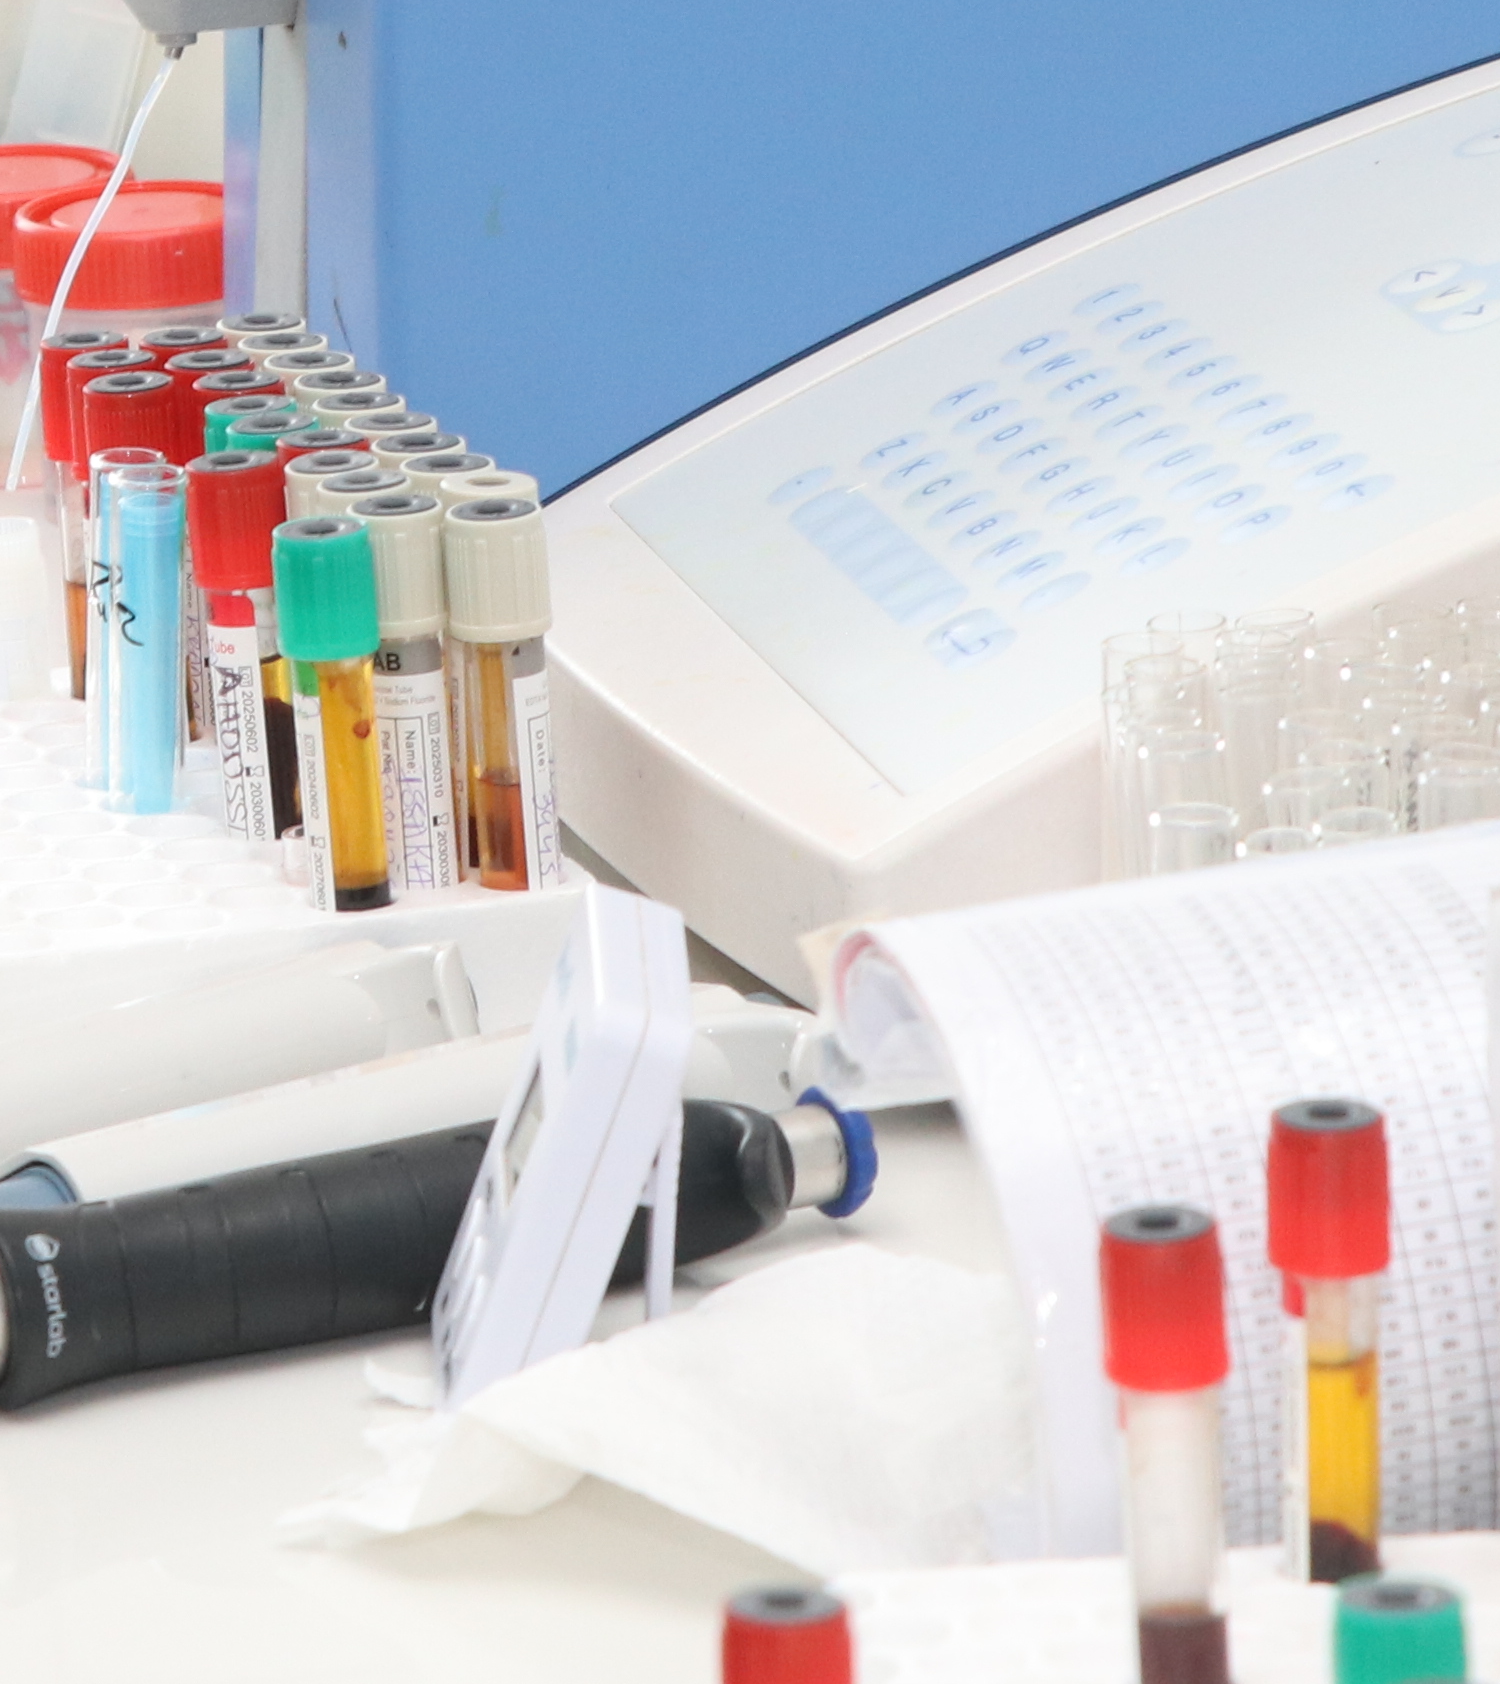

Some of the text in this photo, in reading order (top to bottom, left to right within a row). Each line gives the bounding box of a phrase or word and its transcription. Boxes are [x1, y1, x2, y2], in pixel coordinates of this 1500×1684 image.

[1115, 307, 1144, 322] 2
[1138, 325, 1167, 341] 3
[1167, 345, 1190, 358] 4
[1187, 362, 1216, 378] 5
[1211, 382, 1240, 396] 6
[1263, 421, 1292, 435] 8
[1289, 441, 1317, 455] 9
[1316, 461, 1342, 476] 0
[1019, 338, 1049, 355] Q
[1043, 355, 1075, 372] W
[1066, 373, 1097, 391] E
[1088, 393, 1120, 410] R
[1112, 411, 1145, 428] T
[1140, 430, 1171, 445] Y
[1162, 451, 1194, 467] U
[1212, 491, 1244, 508] O
[1238, 513, 1271, 529] P
[948, 389, 1167, 564] A S D F G H J K L
[878, 439, 1047, 577] Z X C V B N M
[374, 653, 401, 672] AB
[242, 691, 258, 753] 20250602
[404, 730, 417, 776] Name:
[534, 729, 546, 773] Date:
[430, 736, 445, 798] 20250310
[249, 781, 265, 841] 2030060
[37, 1262, 69, 1360] starlab
